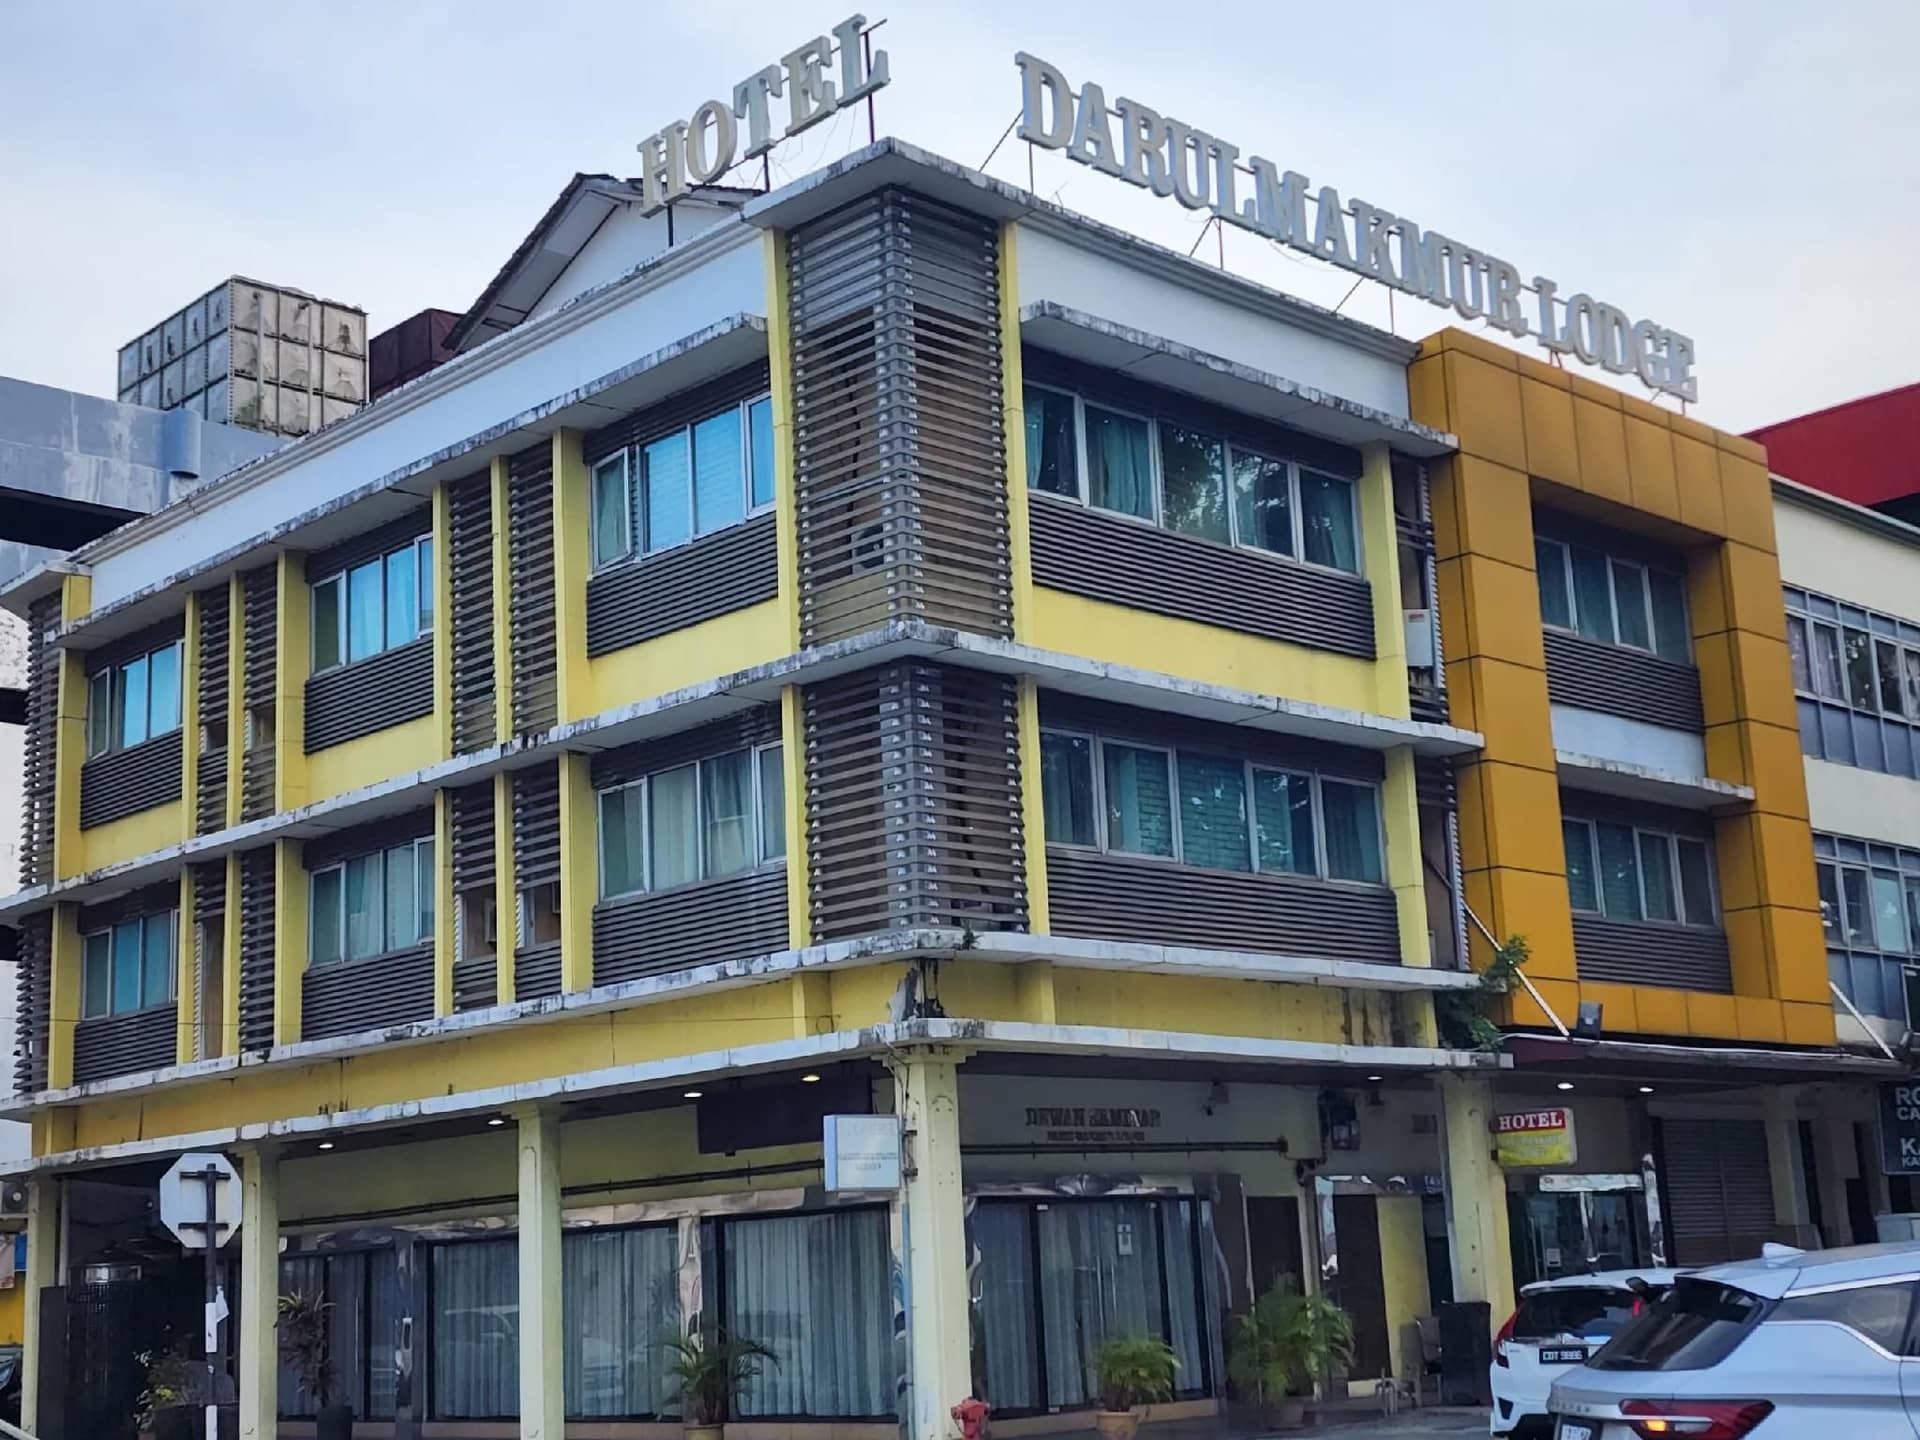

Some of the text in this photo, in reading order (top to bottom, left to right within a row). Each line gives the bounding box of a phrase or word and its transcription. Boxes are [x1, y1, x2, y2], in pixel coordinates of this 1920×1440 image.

[637, 13, 891, 219] HOTEL
[1532, 275, 1698, 404] LODGE
[1025, 1107, 1085, 1127] DEWAN
[1498, 1111, 1563, 1131] HOTEL
